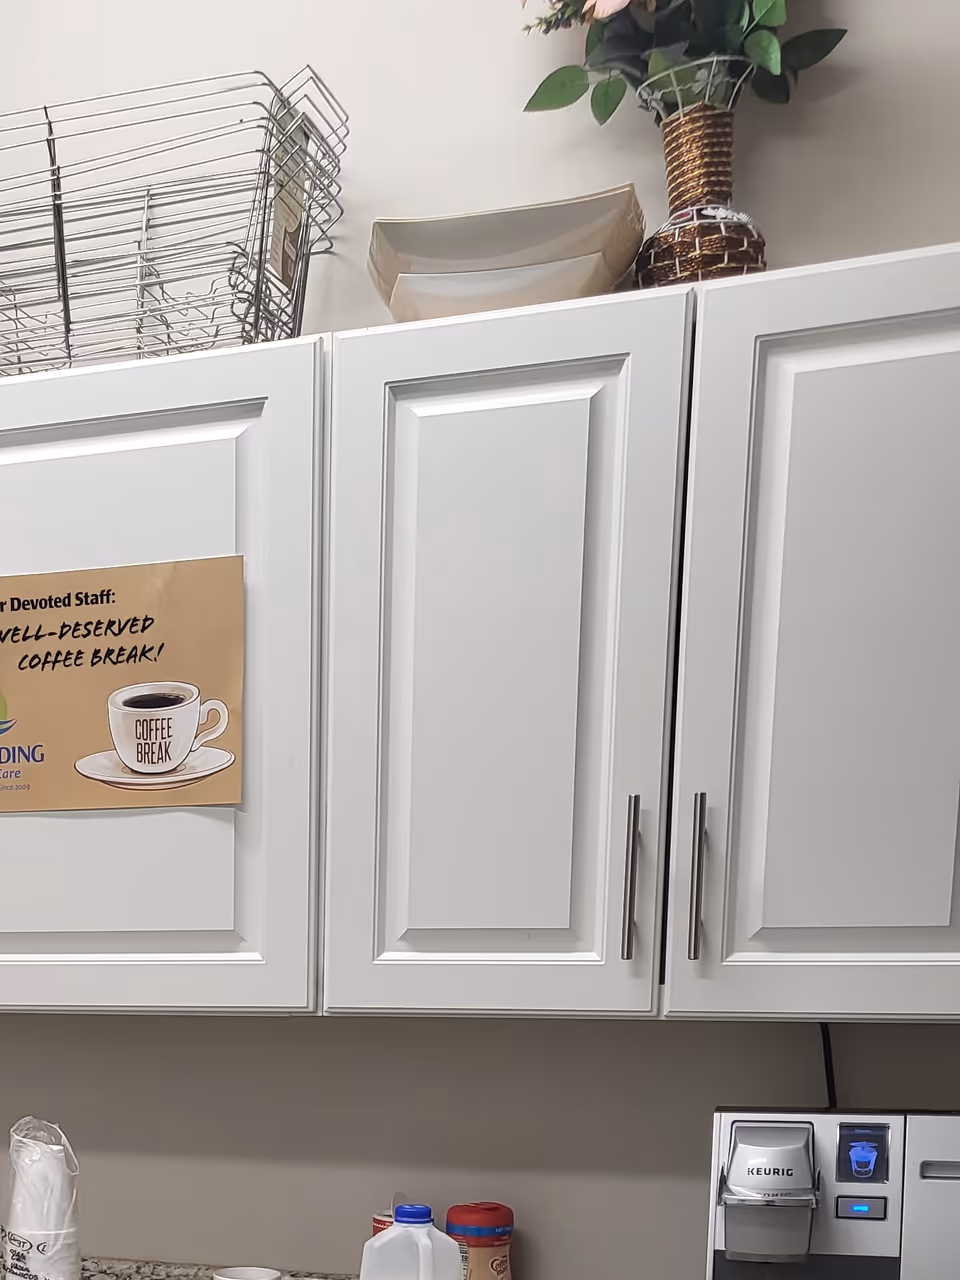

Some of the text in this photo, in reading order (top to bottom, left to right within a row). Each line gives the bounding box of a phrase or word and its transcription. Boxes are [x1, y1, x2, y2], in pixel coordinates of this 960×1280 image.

[10, 595, 71, 612] Devoted
[75, 589, 116, 606] Staff:
[18, 642, 165, 672] COFFEE BREAK!
[135, 717, 173, 741] COFFEE
[136, 741, 172, 765] BREAK
[746, 1167, 794, 1177] KEURIG
